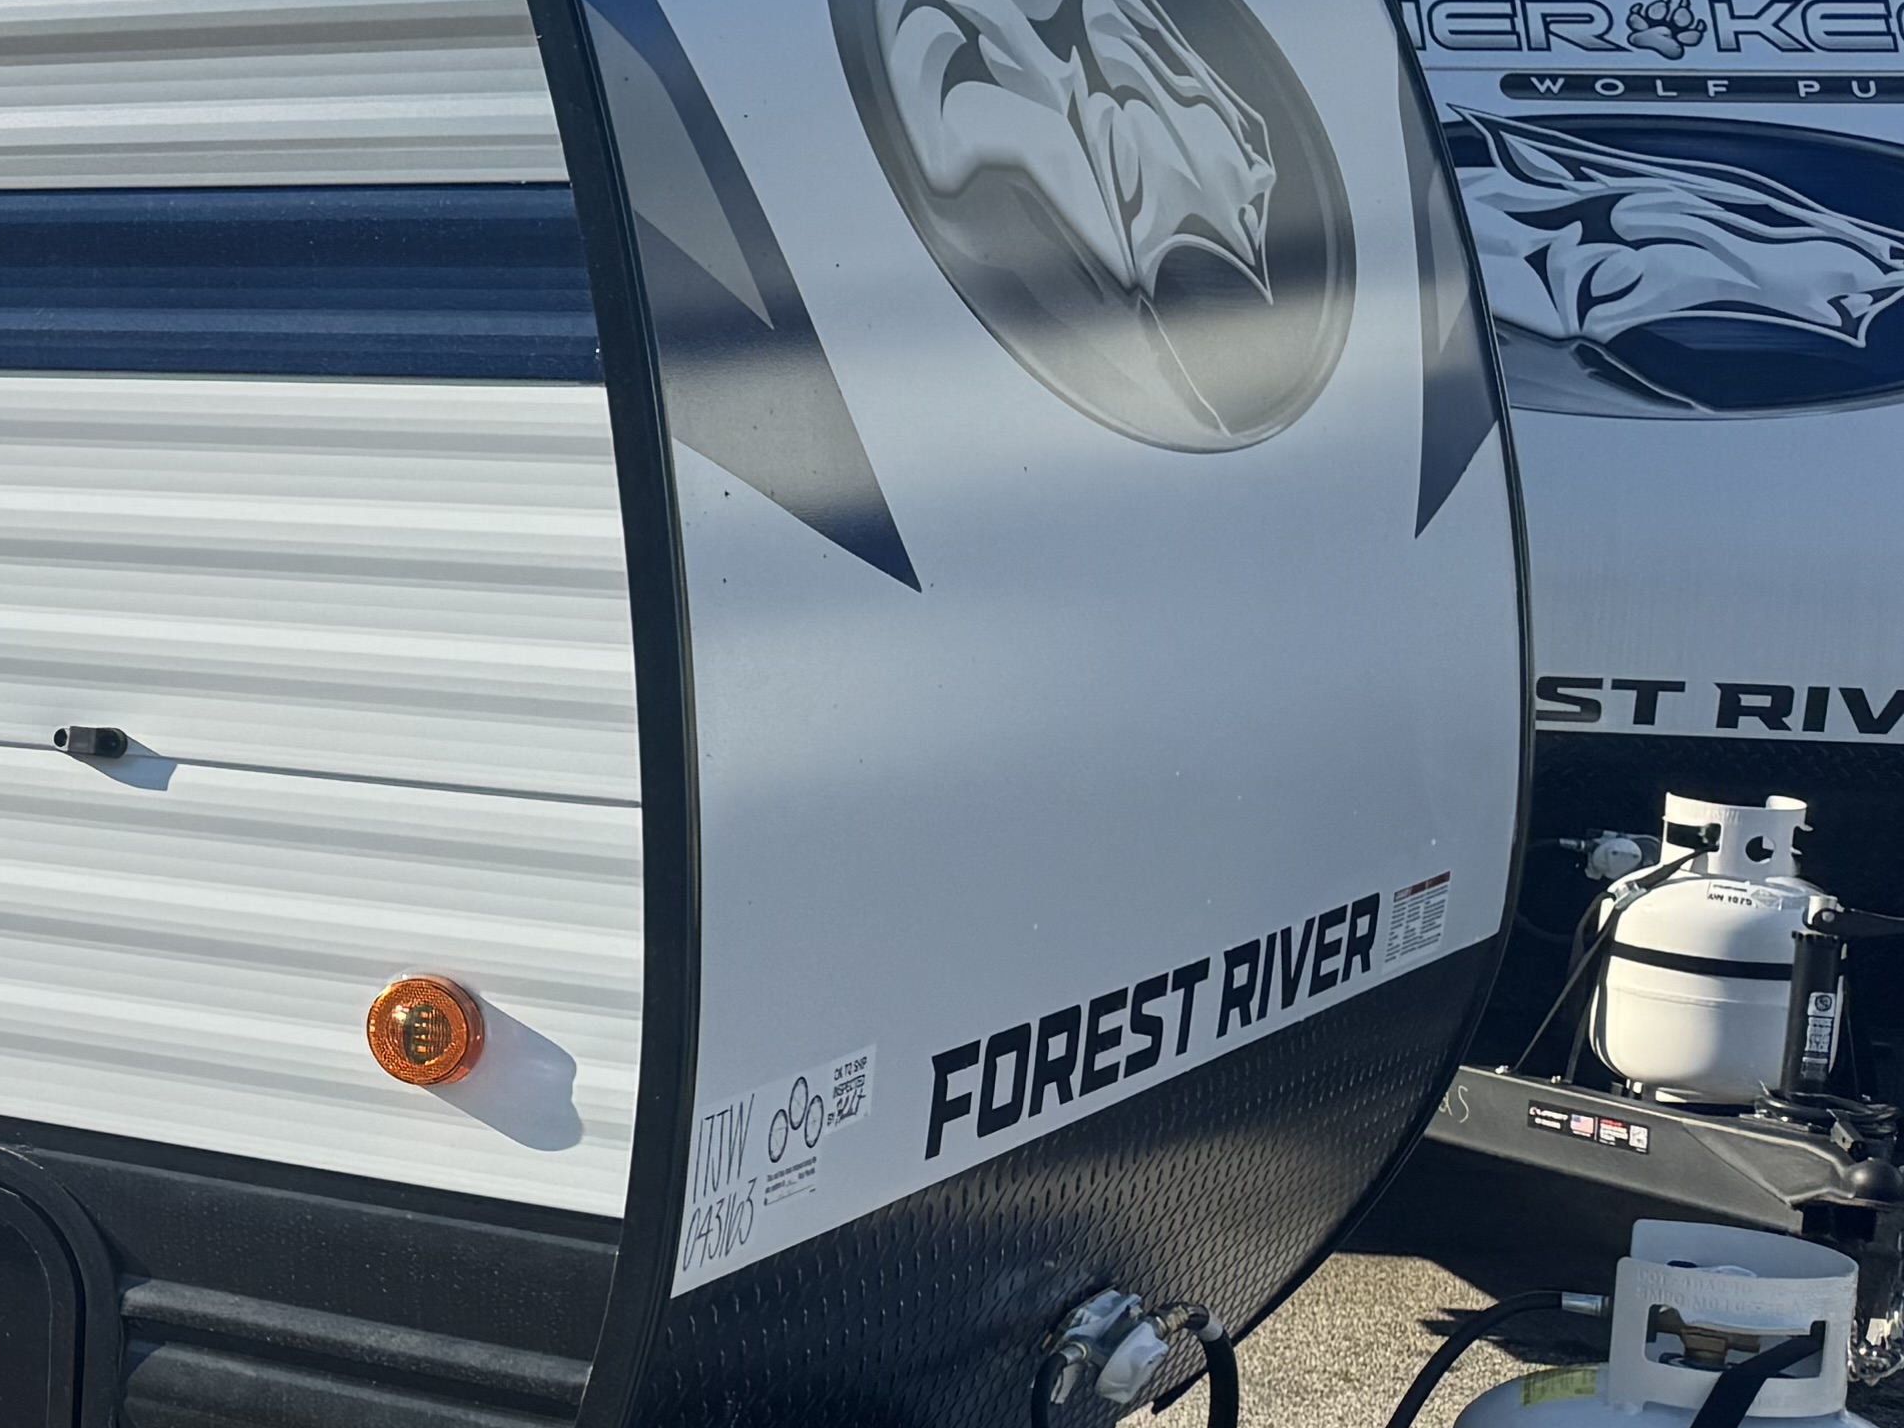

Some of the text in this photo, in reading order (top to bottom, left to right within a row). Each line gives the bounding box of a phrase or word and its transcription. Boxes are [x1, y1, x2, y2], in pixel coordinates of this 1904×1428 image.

[1530, 76, 1878, 99] WOLF PU
[925, 953, 1211, 1160] FOREST
[1215, 892, 1381, 1039] RIVER
